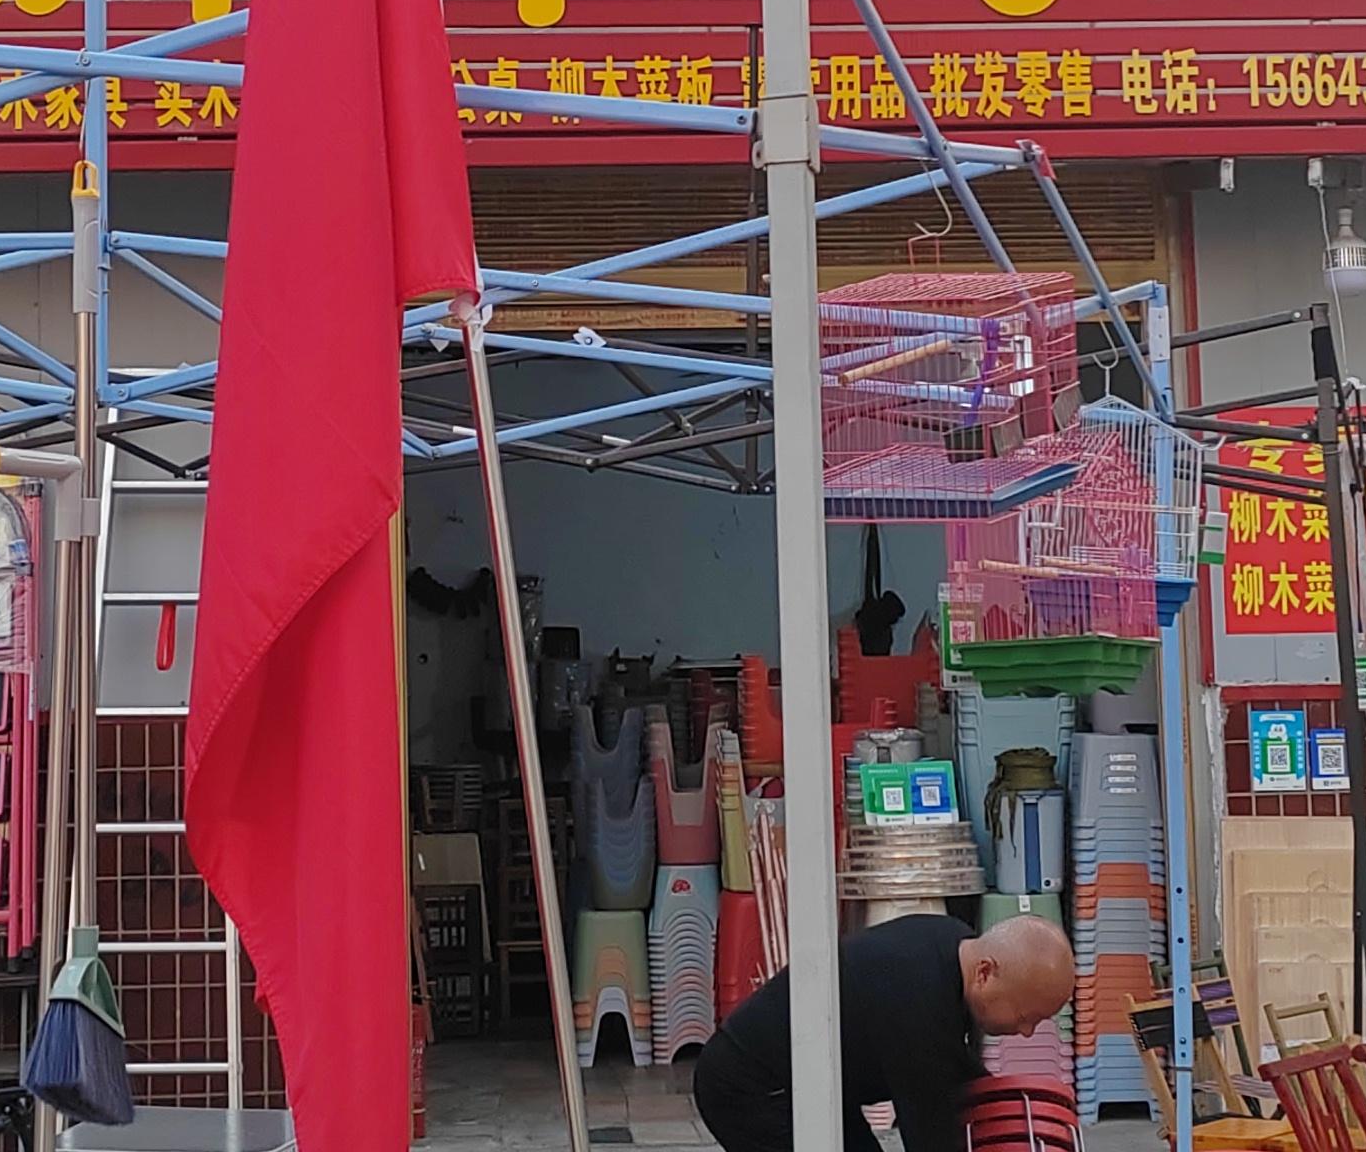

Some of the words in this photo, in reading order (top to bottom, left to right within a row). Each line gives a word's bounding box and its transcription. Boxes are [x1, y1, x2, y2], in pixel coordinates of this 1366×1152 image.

[931, 50, 1093, 119] 批发零售
[1121, 48, 1217, 115] 电话：
